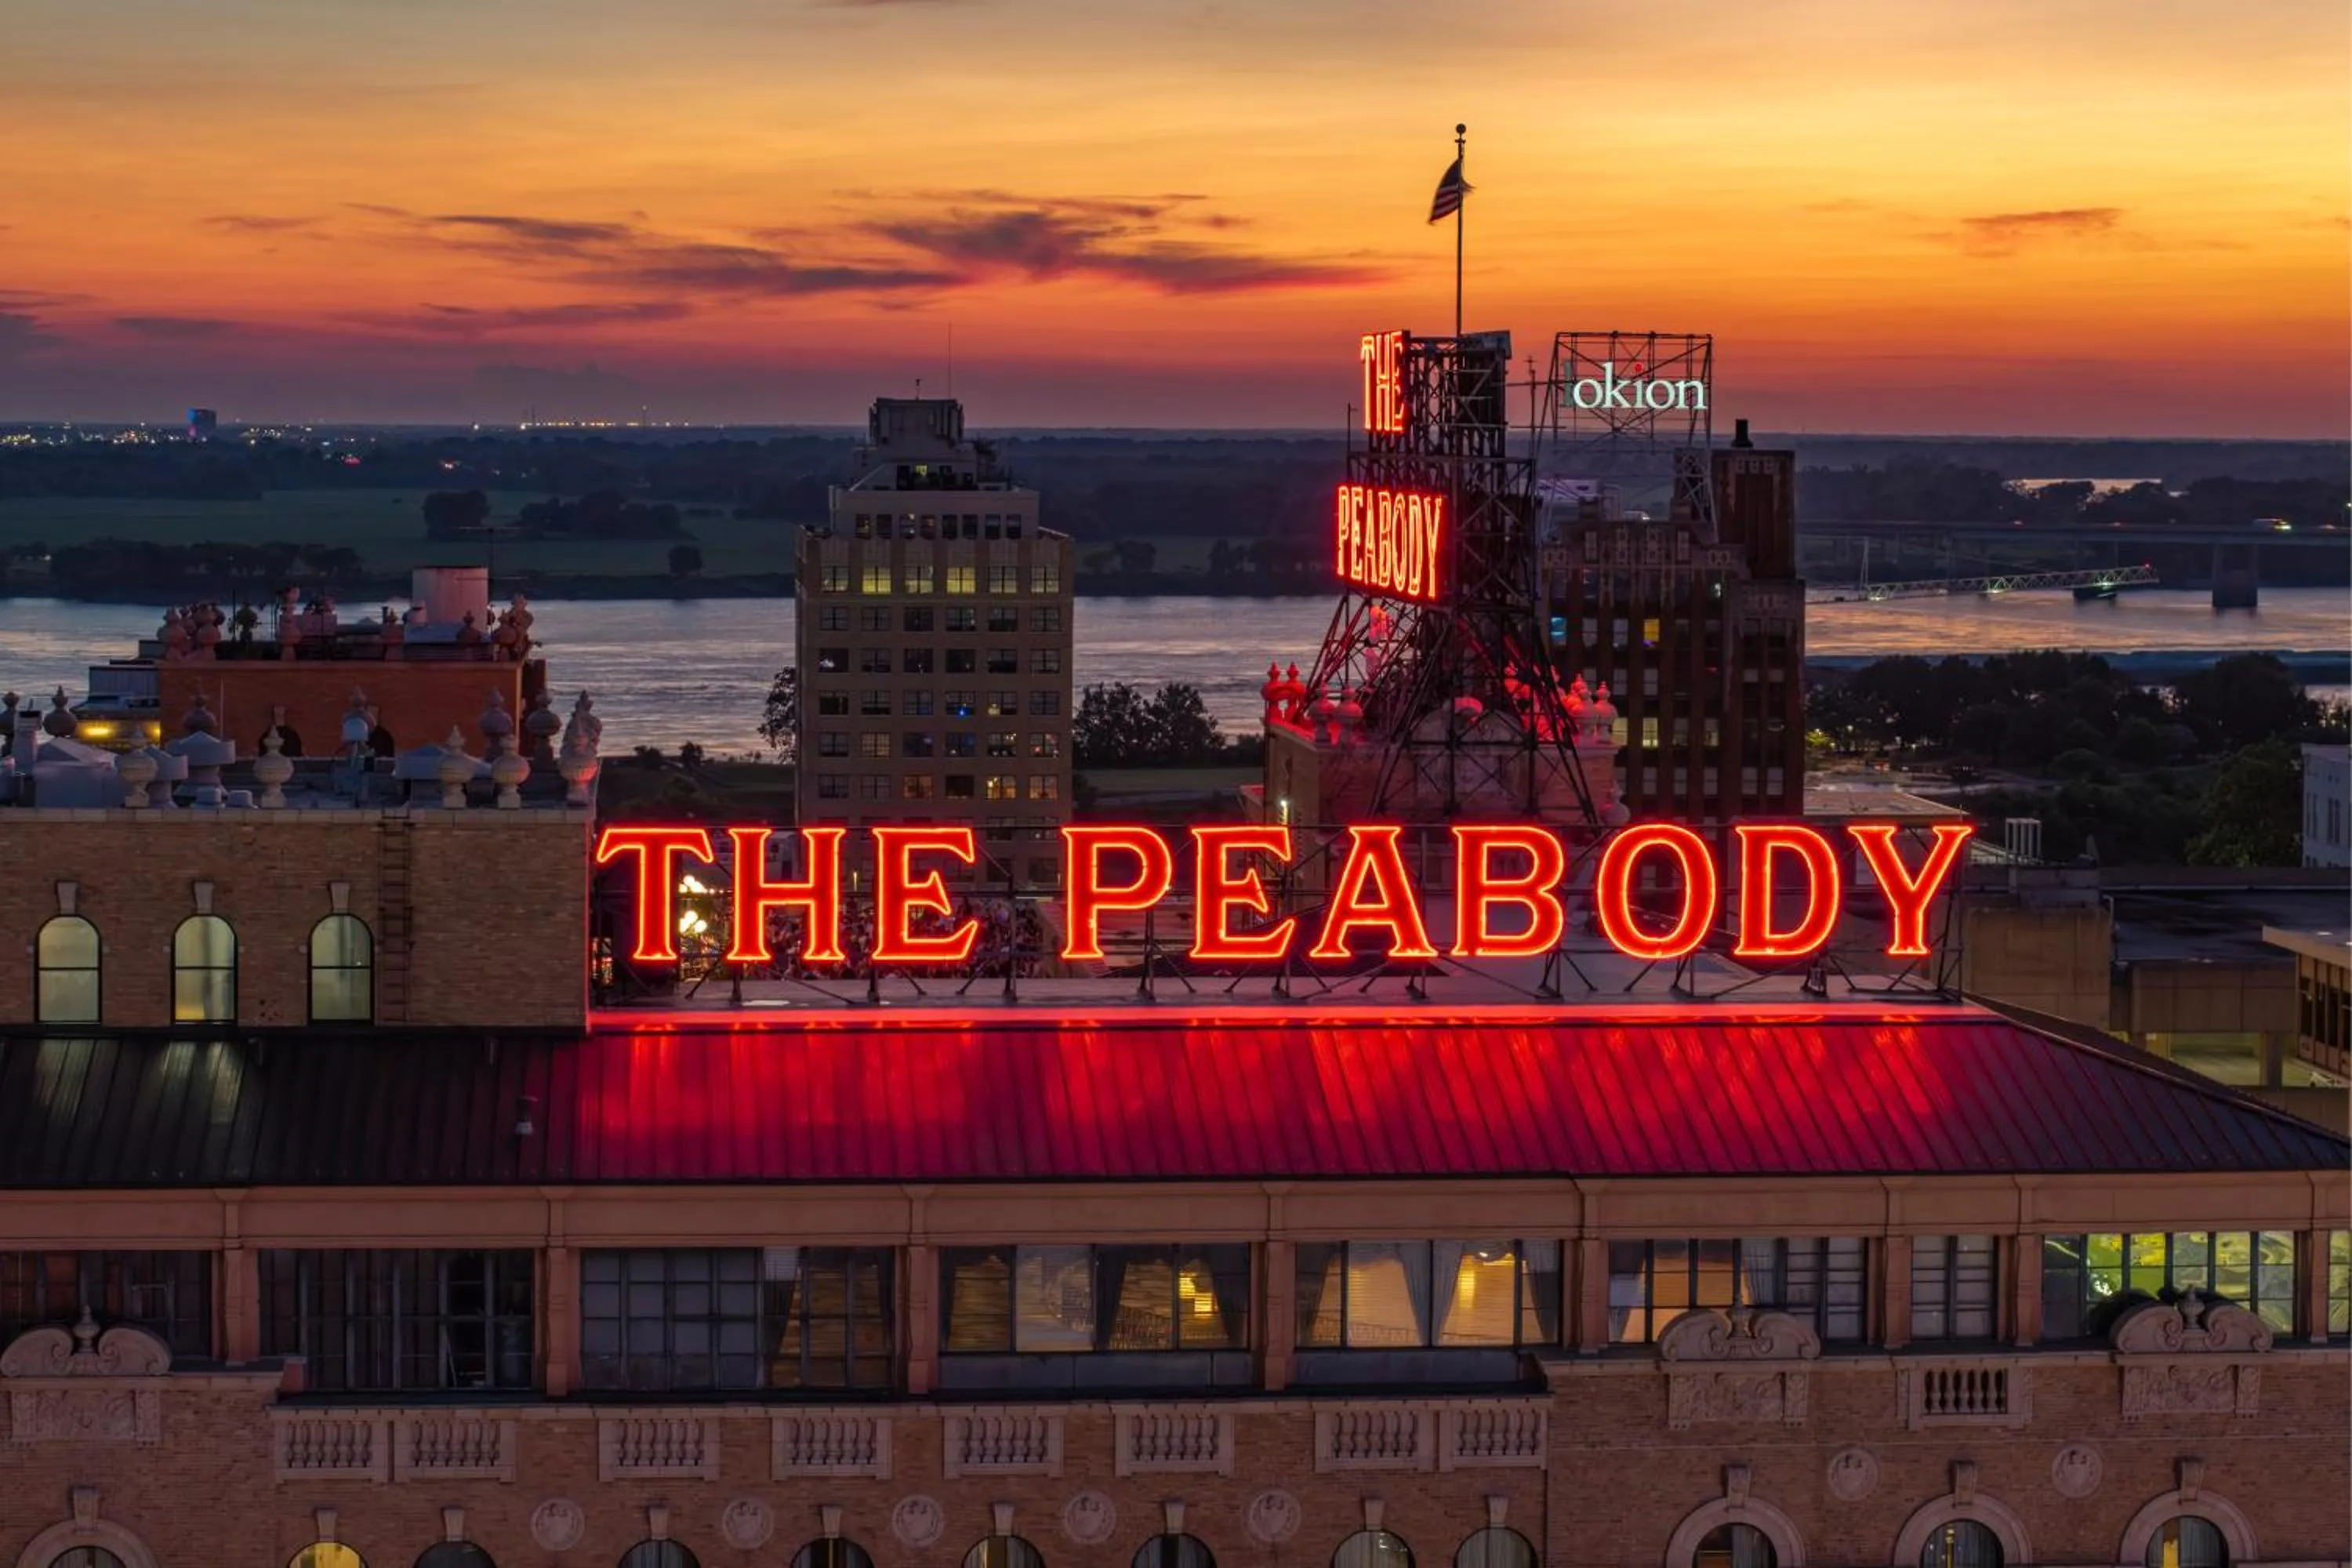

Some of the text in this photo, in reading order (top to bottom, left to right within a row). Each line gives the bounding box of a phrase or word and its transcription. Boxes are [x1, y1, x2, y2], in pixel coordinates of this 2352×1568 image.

[1361, 332, 1404, 432] THE
[1337, 485, 1441, 599] PEABODY
[597, 823, 1973, 960] THE PEABODY
